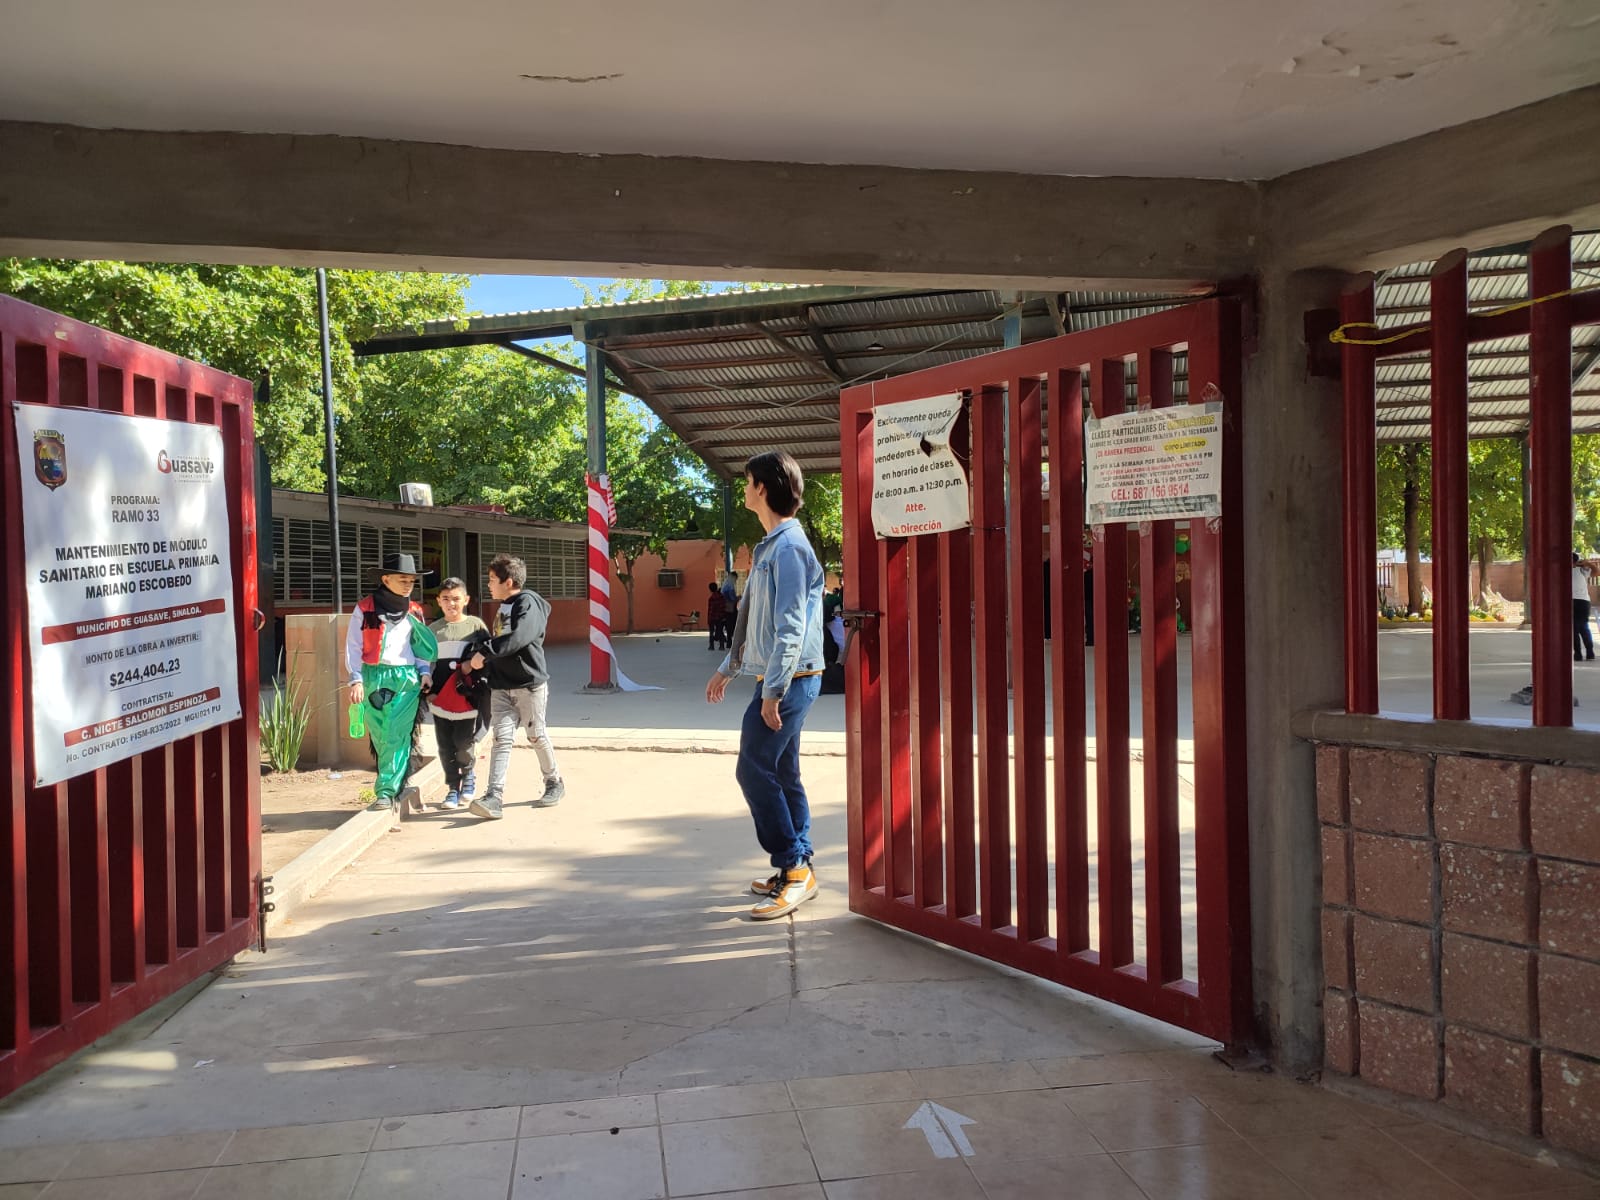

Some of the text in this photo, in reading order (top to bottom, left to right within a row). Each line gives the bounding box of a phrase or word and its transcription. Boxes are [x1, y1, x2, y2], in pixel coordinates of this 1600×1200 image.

[928, 409, 952, 420] queda
[1112, 424, 1156, 437] PARTICULARES
[1158, 422, 1166, 431] DE
[158, 450, 214, 474] Guasave
[874, 449, 916, 464] vendedores
[892, 466, 918, 478] horario
[920, 464, 928, 473] de
[930, 460, 954, 471] clases
[874, 490, 884, 499] de
[886, 488, 902, 498] 8:00
[904, 486, 918, 495] a.m.
[926, 480, 944, 490] 12:30
[1112, 482, 1189, 500] CEL: 687 156 9514
[111, 495, 160, 505] PROGRAMA:
[905, 503, 926, 513] Atte.
[112, 510, 160, 523] RAMO 33
[900, 520, 942, 534] Dirección
[56, 537, 208, 561] MANTENIMIENTO DE MÓDULO
[39, 554, 220, 584] SANITARIO EN ESCUELA PRIMARIA
[86, 574, 192, 600] MARIANO ESCOBEDO
[76, 606, 202, 635] MUNICIPIO DE GUASAVE, SINALOA.
[86, 652, 114, 665] MONTO
[114, 650, 124, 658] DE
[126, 647, 138, 656] LA
[138, 642, 158, 654] OBRA
[167, 633, 200, 647] INVERTIR:
[110, 658, 180, 688] $244,404.23
[121, 690, 174, 712] CONTRATISTA:
[81, 694, 208, 740] C. NICTE SALOMON ESPINOZA
[82, 736, 129, 758] CONTRATO:
